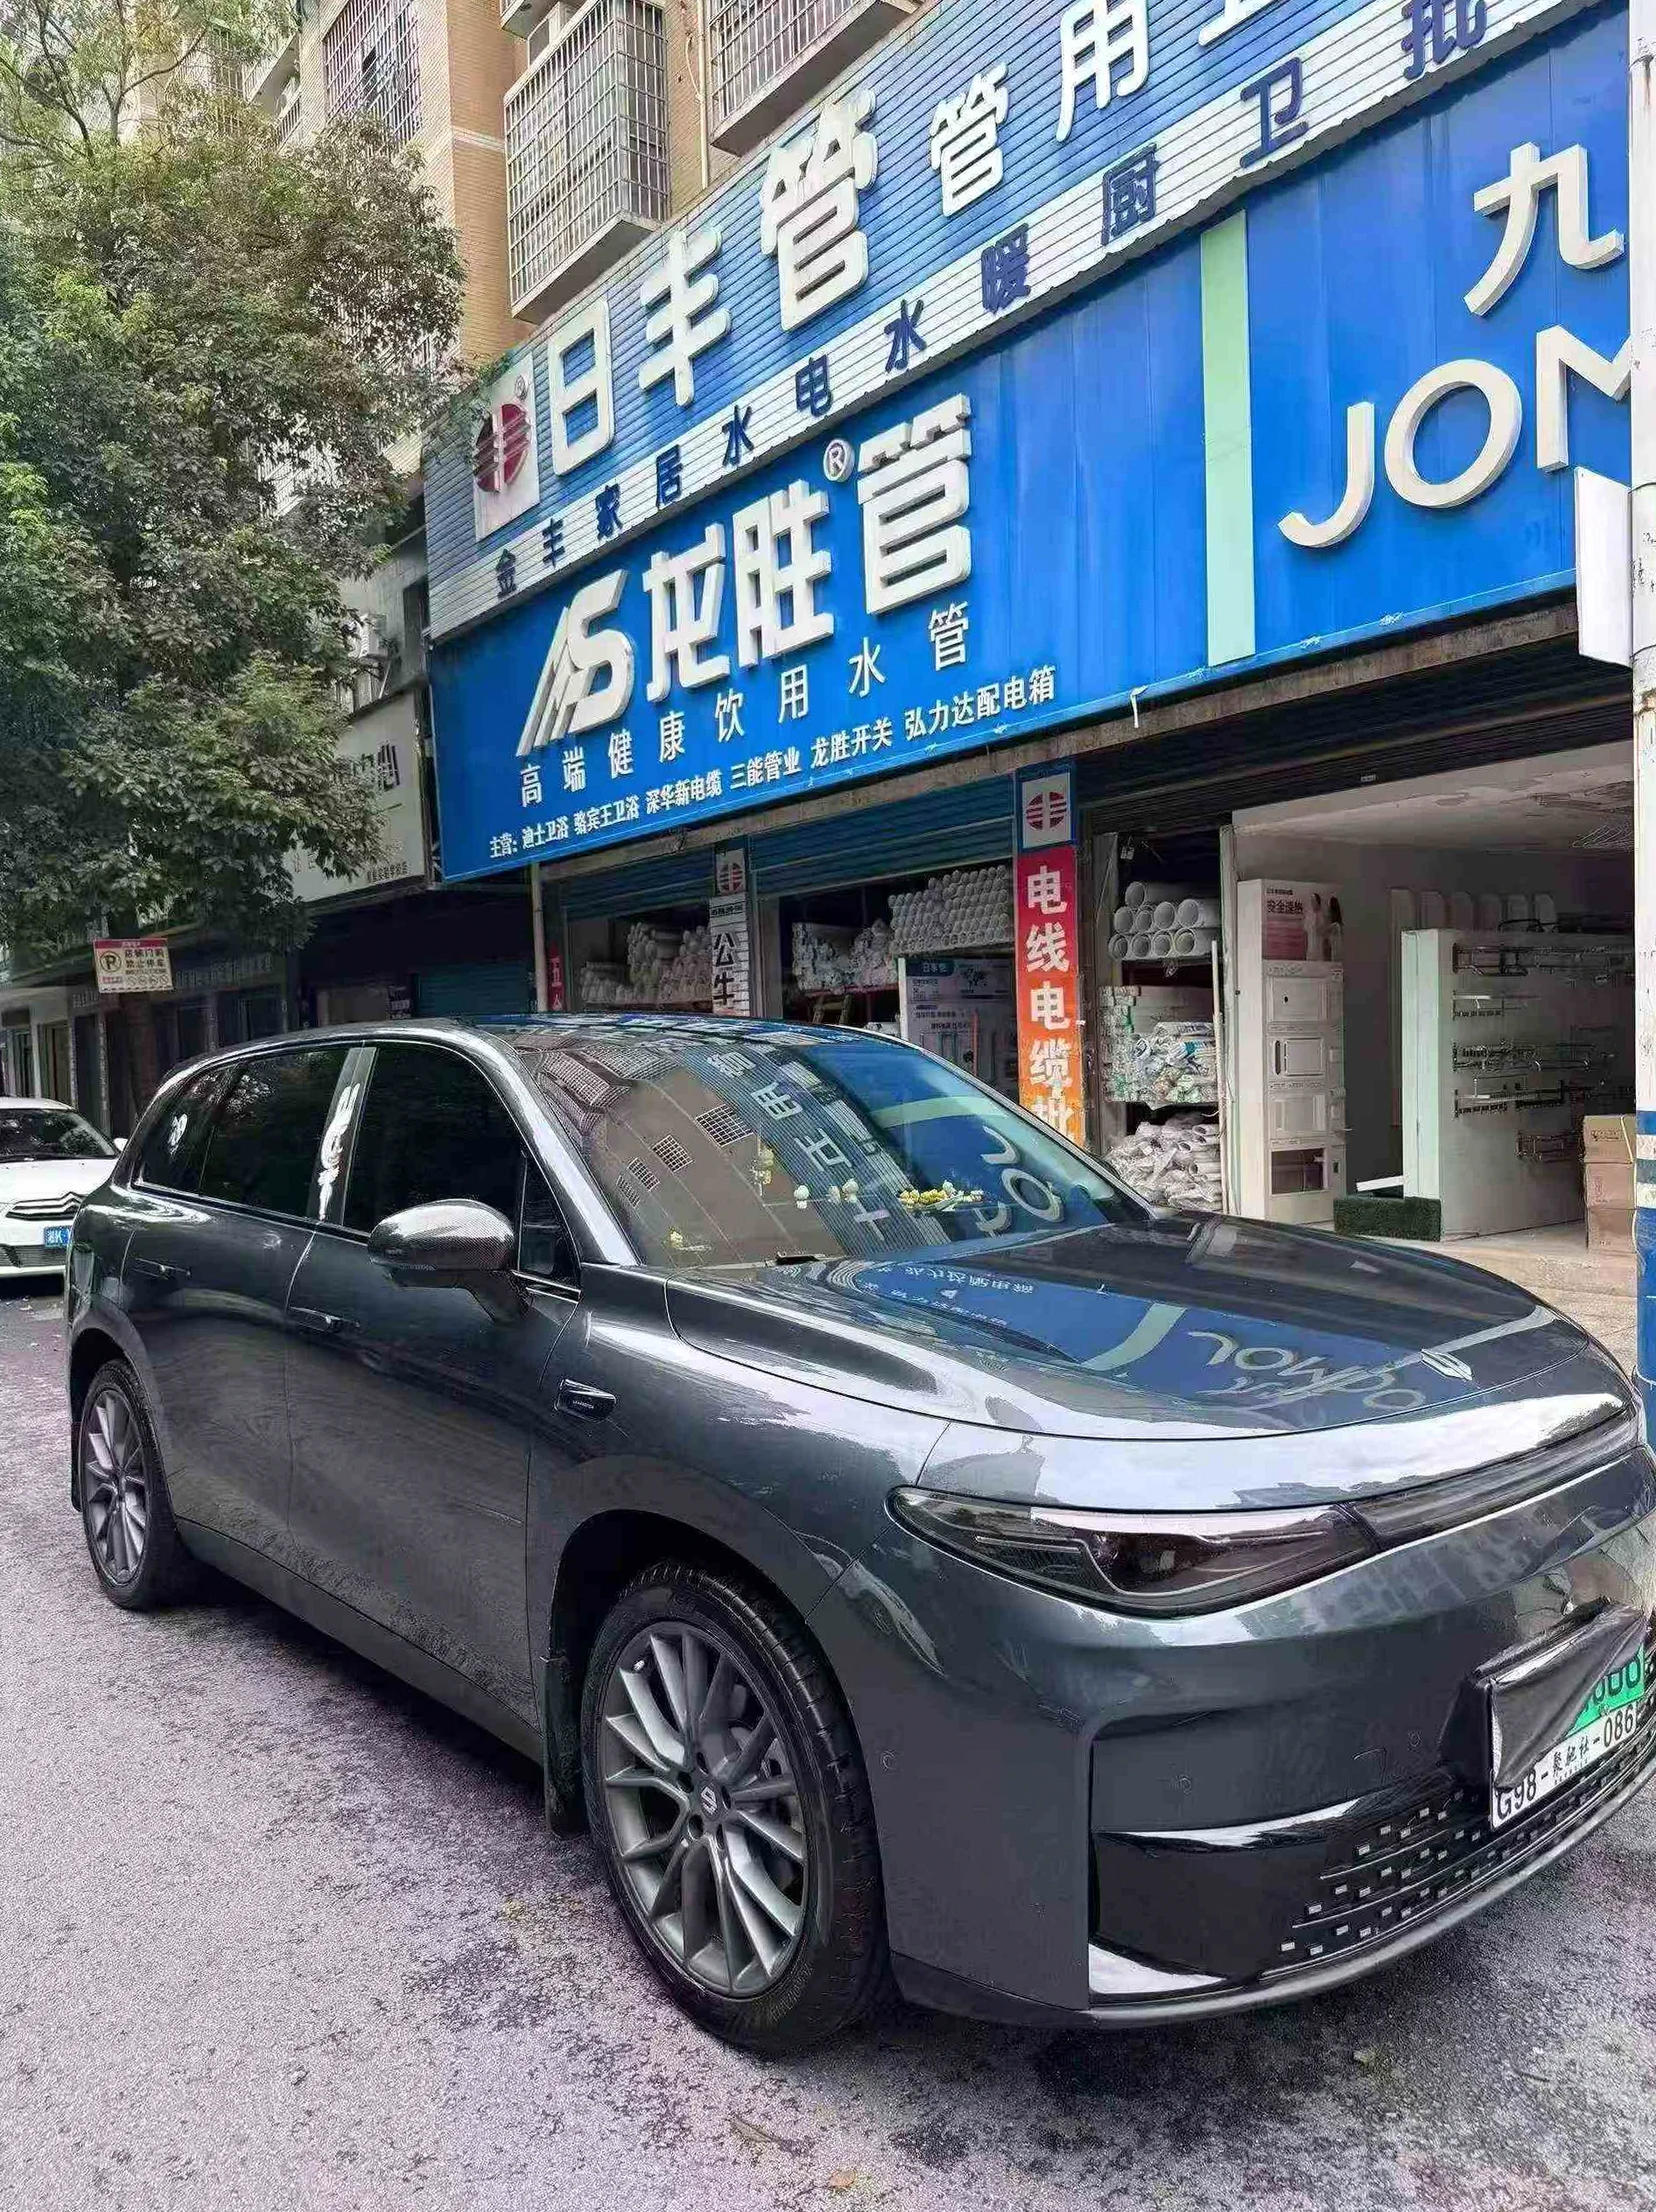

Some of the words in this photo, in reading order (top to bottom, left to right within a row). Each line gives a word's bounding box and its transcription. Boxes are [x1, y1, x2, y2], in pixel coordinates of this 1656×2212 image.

[548, 88, 879, 476] 日丰管
[1463, 141, 1625, 317] 九
[520, 600, 969, 808] 高端健康饮用水管
[730, 746, 802, 790] 三能管业
[810, 717, 894, 769] 龙胜开关
[904, 665, 1056, 741] 弘力达配电箱
